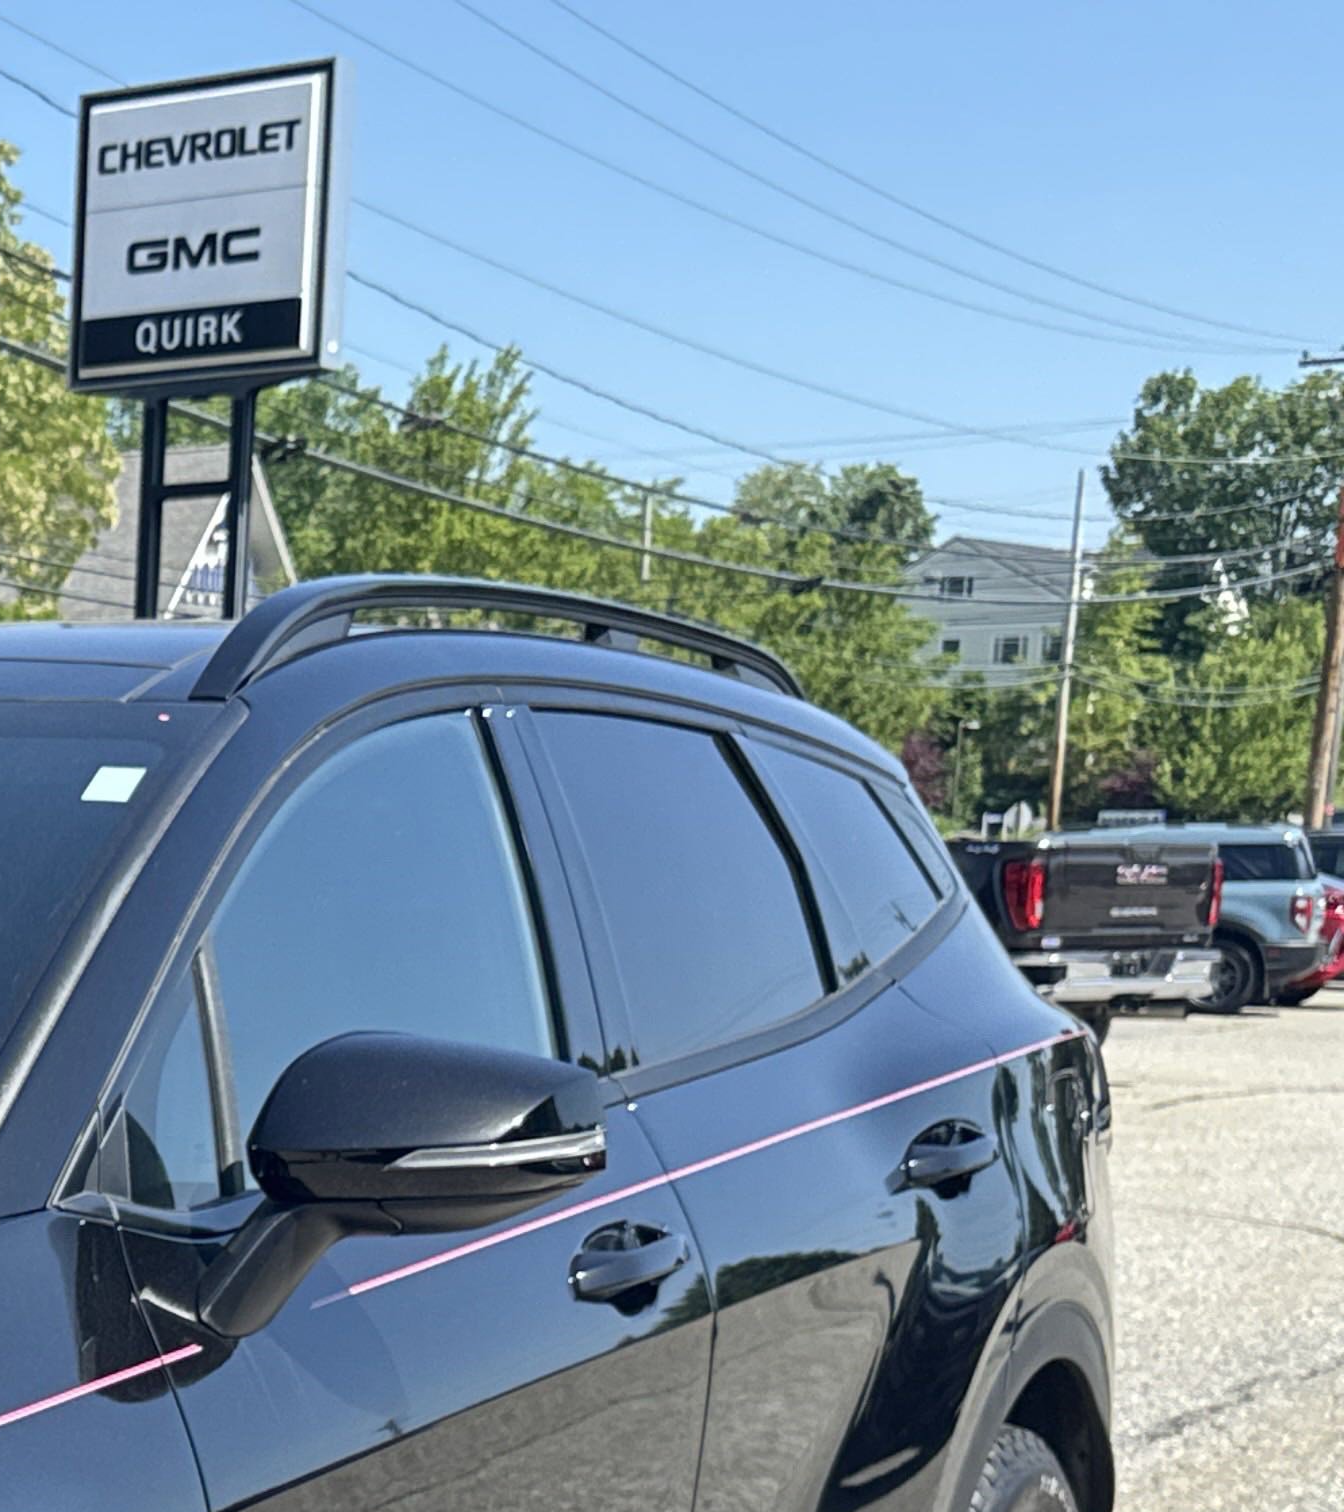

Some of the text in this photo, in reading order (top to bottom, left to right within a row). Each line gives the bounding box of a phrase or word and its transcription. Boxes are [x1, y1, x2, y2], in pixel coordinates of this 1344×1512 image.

[97, 118, 302, 176] CHEVROLET
[125, 226, 262, 276] GMC
[134, 308, 244, 355] QUIRK
